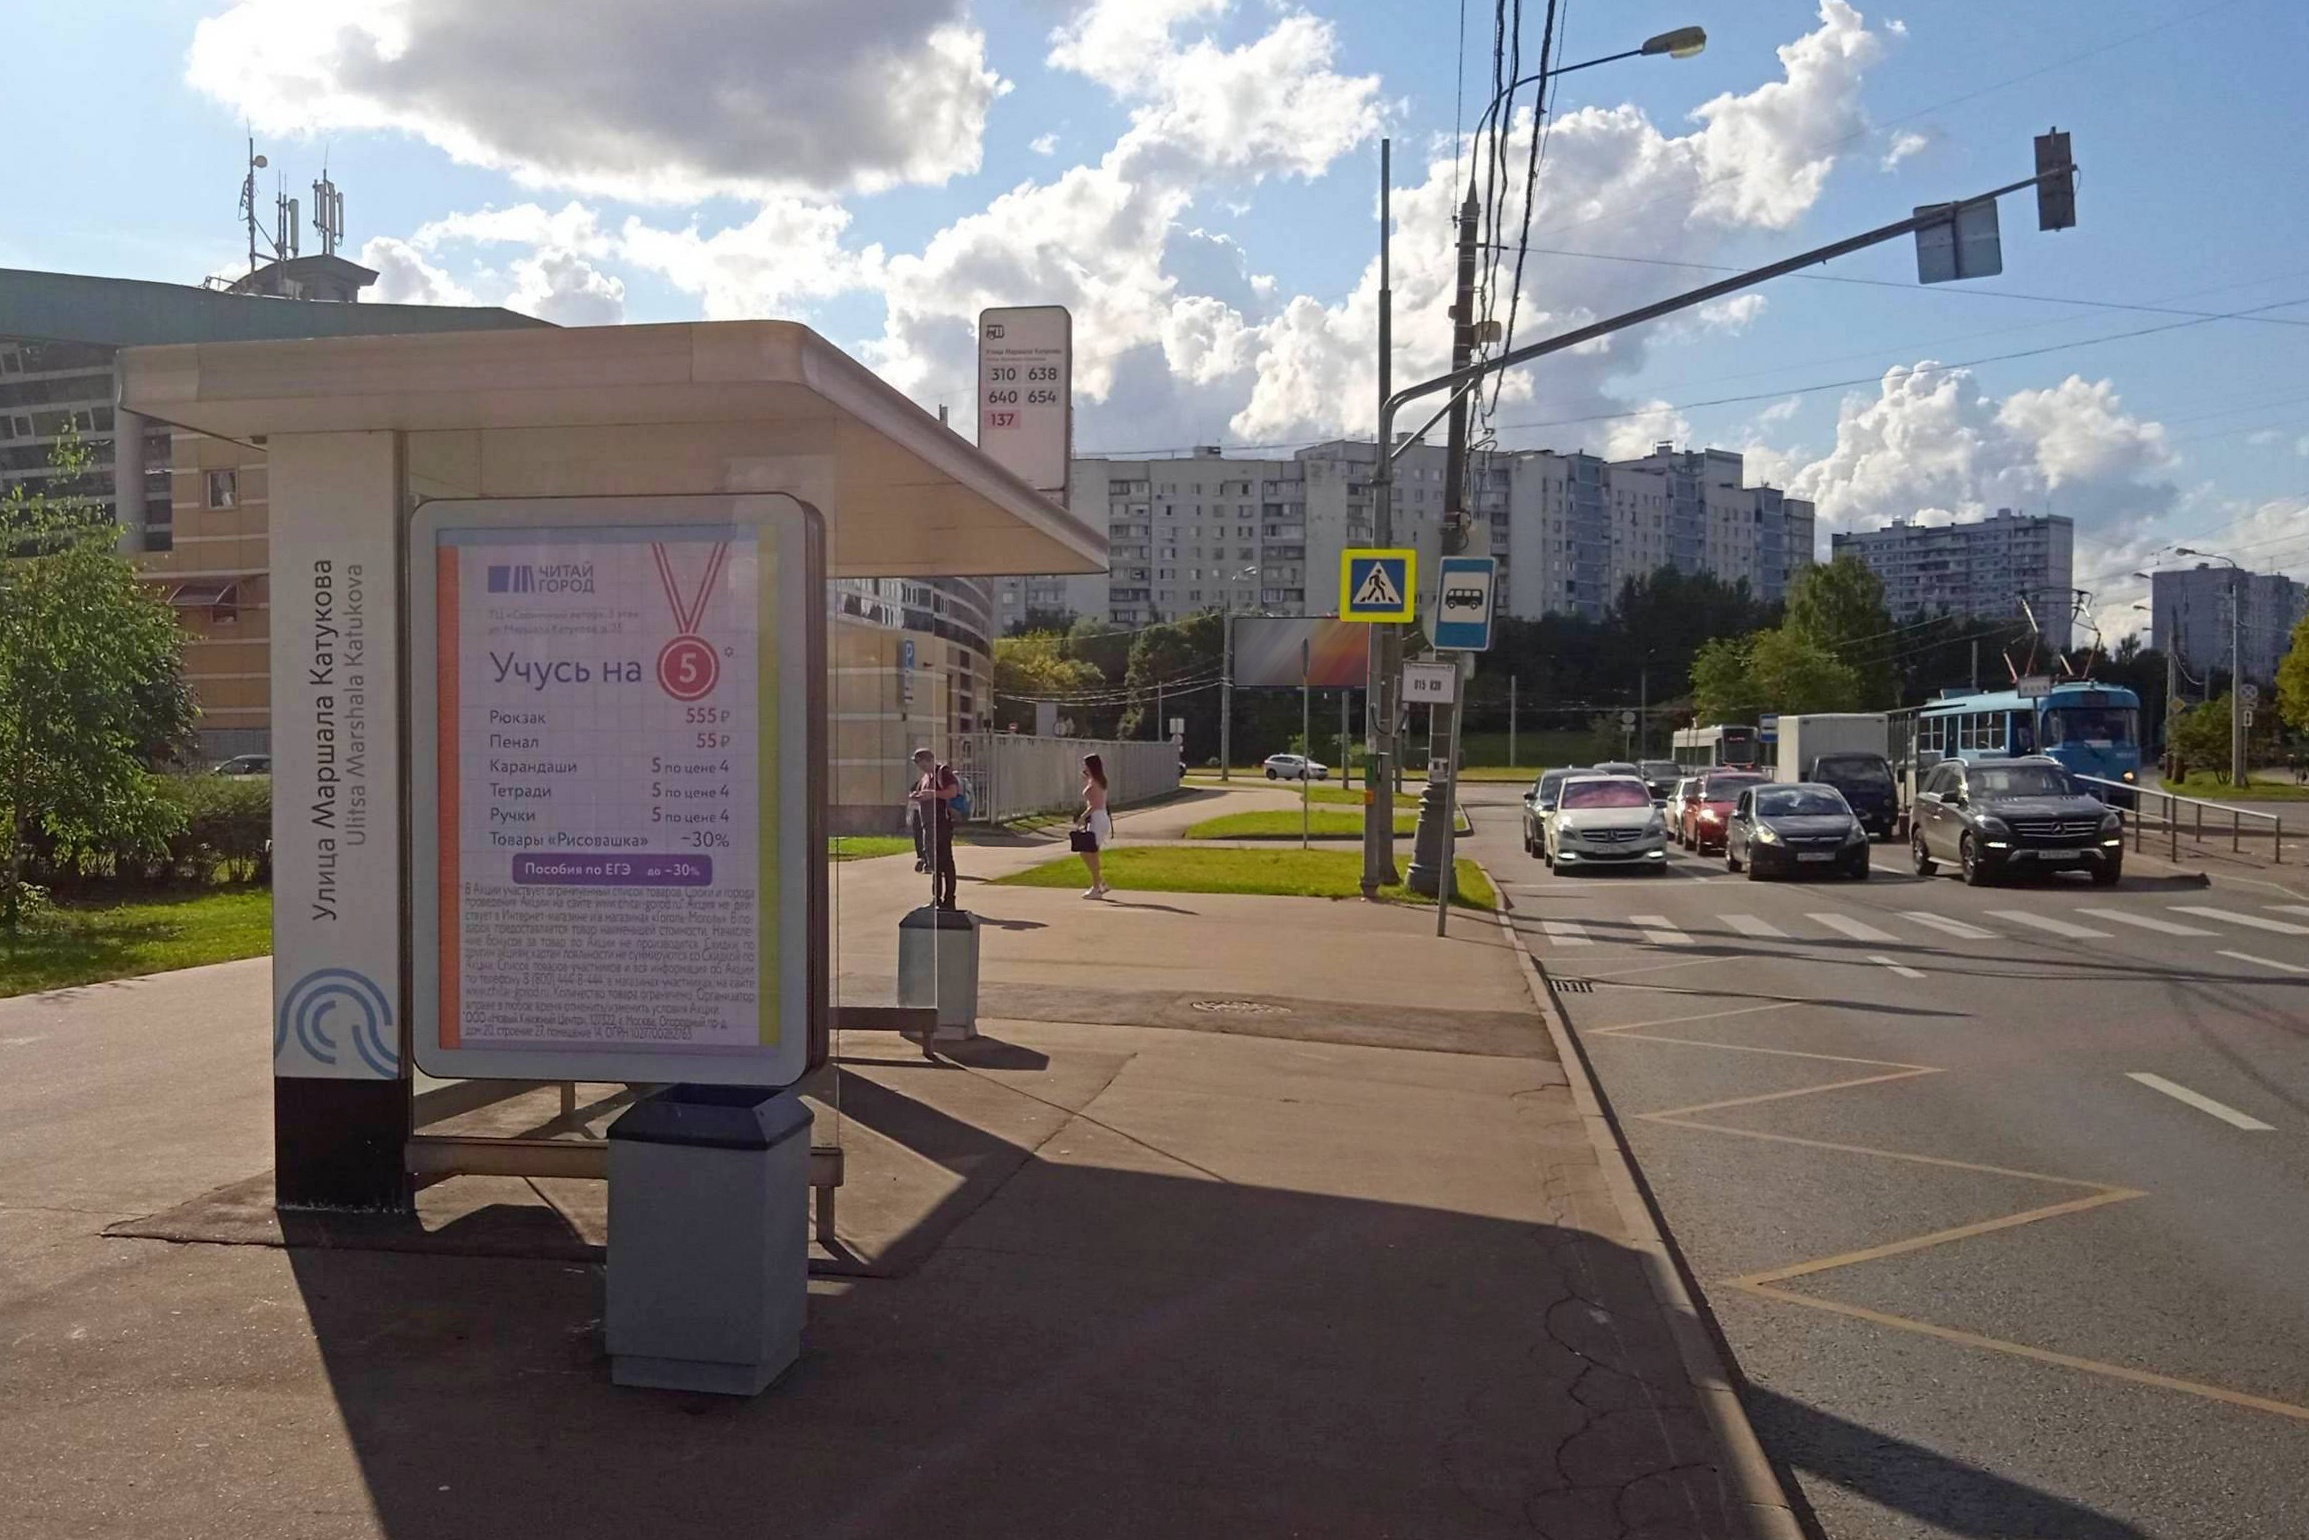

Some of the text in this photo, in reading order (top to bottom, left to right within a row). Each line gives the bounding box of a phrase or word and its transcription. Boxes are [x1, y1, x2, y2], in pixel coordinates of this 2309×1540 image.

[992, 367, 1057, 381] 310 638
[989, 391, 1056, 404] 640 654
[991, 413, 1015, 426] 137
[538, 561, 594, 578] ЧИТАЙ
[538, 578, 596, 594] ГОРОД
[489, 651, 697, 691] Учусь на 5
[342, 564, 366, 846] Ulitsa Marshala Katukova
[489, 709, 546, 724] Рюкзак
[685, 707, 717, 723] 555
[309, 559, 341, 922] Улица Маршала Катукова
[489, 734, 540, 749] Пенал
[696, 732, 717, 748] 55
[489, 757, 730, 775] Карандаши 5 по цене 4
[489, 782, 730, 800] Тетради 5 по цене 4
[489, 806, 730, 824] Ручки 5 по цене 4
[489, 832, 544, 849] Товары
[548, 832, 649, 847] «Рисовашка»
[525, 863, 583, 876] Пособия
[586, 865, 602, 876] по
[605, 863, 631, 876] ЕГЭ
